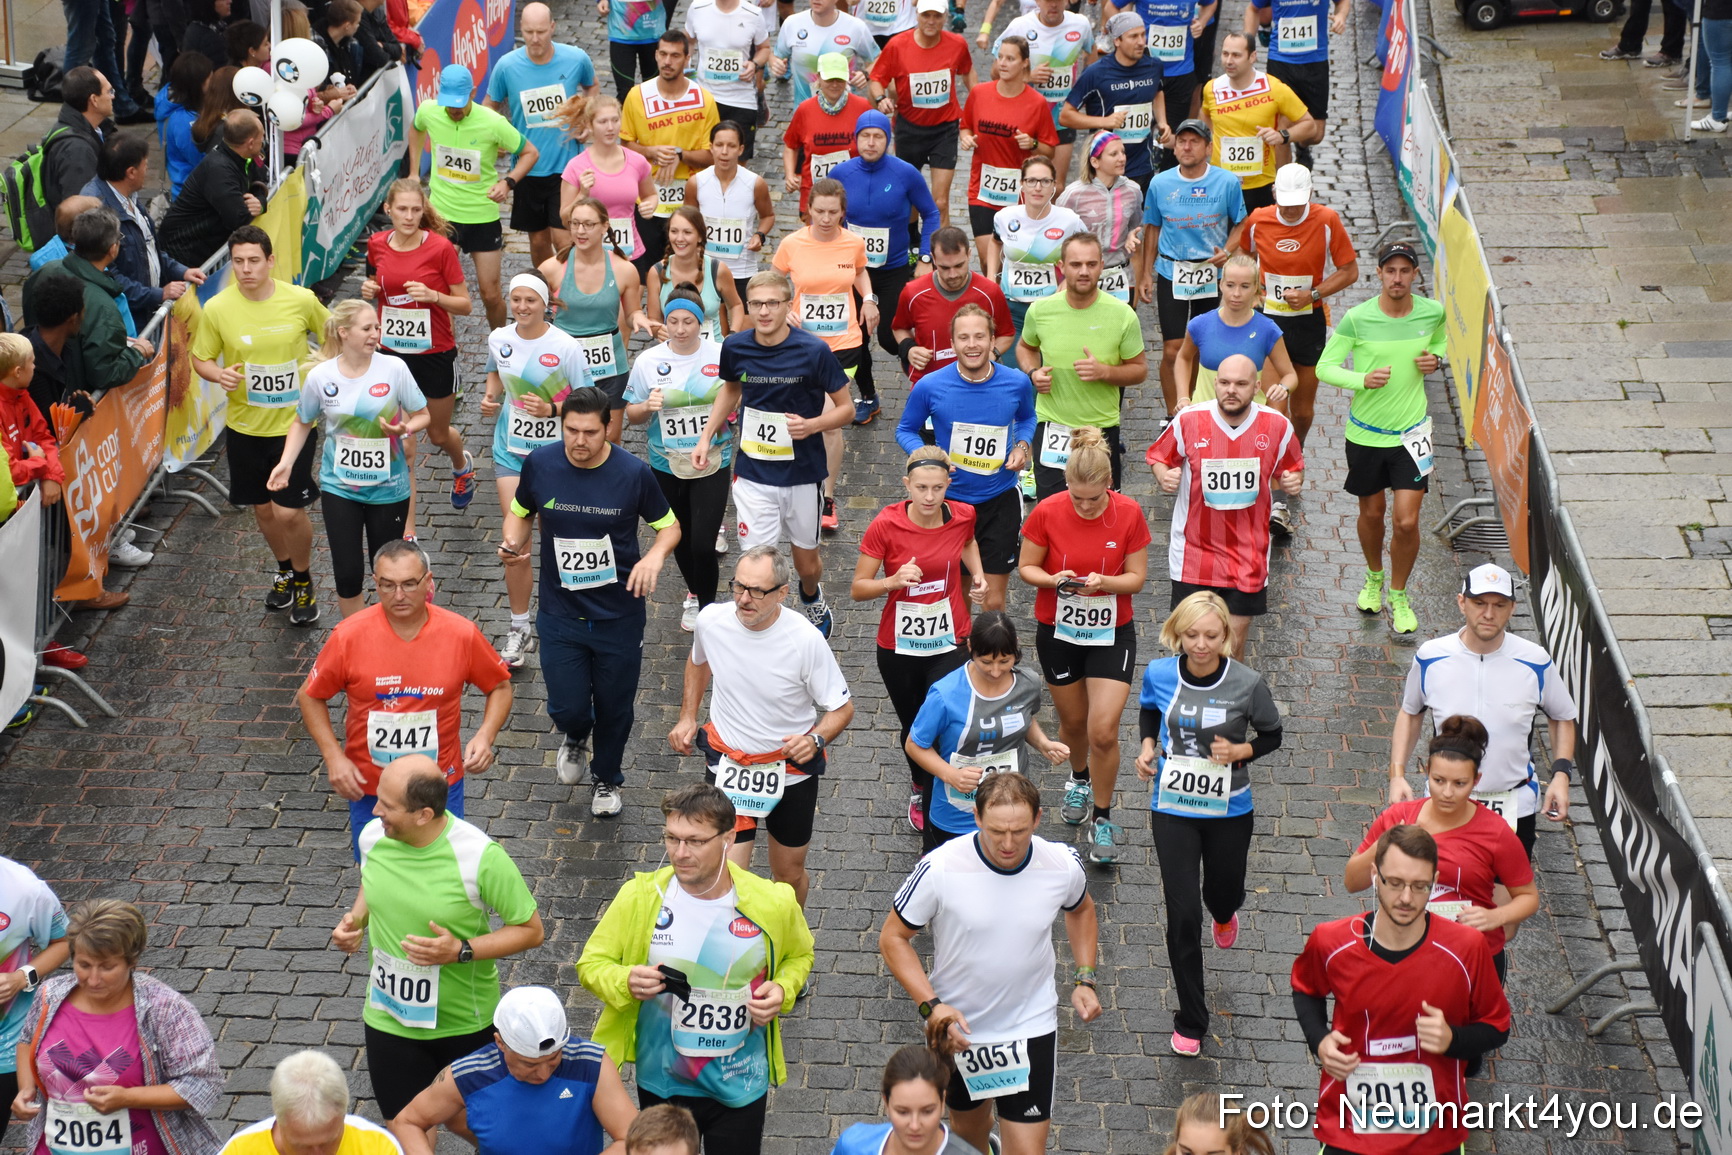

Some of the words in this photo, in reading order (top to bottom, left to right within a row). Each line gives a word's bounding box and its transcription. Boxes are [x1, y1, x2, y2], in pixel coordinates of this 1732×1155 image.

[867, 1, 896, 14] 2226
[1282, 25, 1313, 39] 2141
[453, 15, 487, 69] Hervis
[1152, 34, 1183, 48] 2139
[708, 57, 739, 72] 2285
[915, 79, 948, 97] 2078
[1110, 83, 1129, 92] EURO
[1135, 79, 1153, 88] POLES
[1217, 104, 1241, 116] MAX
[1244, 95, 1274, 110] BÖGL
[648, 117, 674, 132] MAX
[677, 111, 706, 125] BÖGL
[1228, 146, 1255, 162] 326
[444, 155, 472, 172] 246
[1230, 164, 1253, 172] Scherer
[984, 174, 1017, 192] 2754
[659, 187, 685, 203] 323
[988, 190, 1007, 201] Nadine
[706, 226, 742, 243] 2110
[715, 245, 730, 253] Nina
[1014, 270, 1052, 286] 2621
[1178, 268, 1214, 285] 2723
[805, 304, 845, 321] 2437
[386, 319, 426, 337] 2324
[816, 322, 834, 332] Anita
[394, 340, 418, 349] Marina
[251, 372, 295, 392] 2057
[747, 376, 769, 384] GOSSEN
[513, 417, 556, 439] 2282
[666, 415, 709, 437] 3115
[757, 424, 777, 443] 42
[756, 446, 777, 455] Oliver
[963, 435, 997, 457] 196
[340, 448, 385, 469] 2053
[963, 457, 991, 469] Bastian
[345, 470, 378, 481] Christina
[1207, 471, 1255, 491] 3019
[554, 502, 581, 513] GOSSEN
[582, 506, 622, 516] METRAWATT
[561, 550, 611, 571] 2294
[572, 574, 601, 583] Roman
[901, 613, 949, 636] 2374
[1061, 605, 1113, 628] 2599
[1075, 630, 1093, 640] Anja
[909, 638, 943, 650] Veronika
[388, 687, 403, 695] 28.
[403, 687, 421, 695] Mai
[422, 687, 444, 696] 2006
[375, 726, 432, 749] 2447
[722, 767, 780, 796] 2699
[1166, 769, 1225, 797] 2094
[730, 794, 766, 810] Günther
[1177, 796, 1209, 808] Andrea
[376, 965, 432, 1004] 3100
[681, 1002, 747, 1031] 2638
[698, 1036, 727, 1048] Peter
[1382, 1042, 1403, 1051] DEHN
[962, 1041, 1022, 1074] 3051
[970, 1074, 1019, 1092] Walter
[1356, 1082, 1429, 1108] 2018
[53, 1118, 123, 1147] 2064
